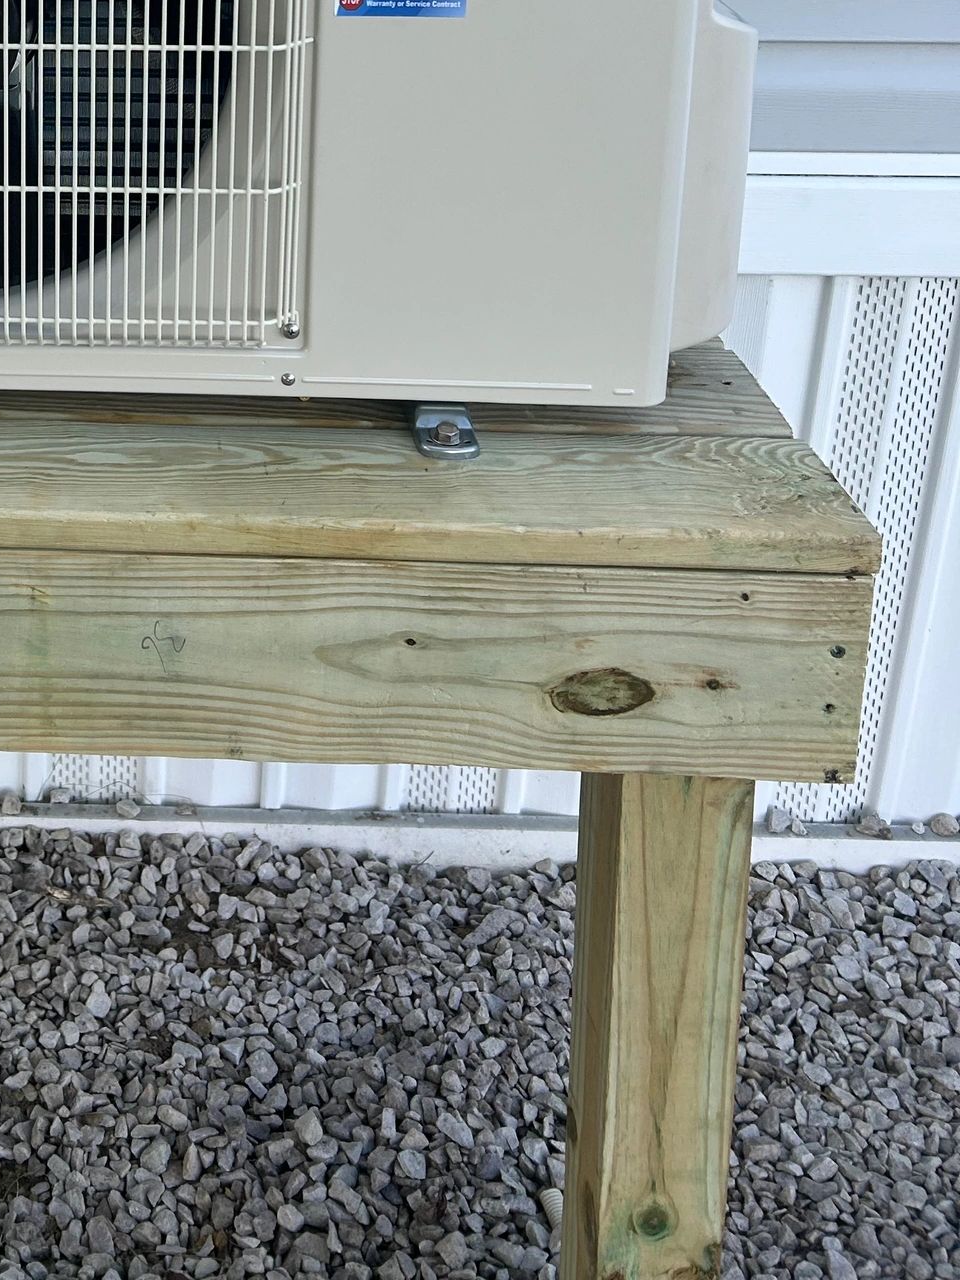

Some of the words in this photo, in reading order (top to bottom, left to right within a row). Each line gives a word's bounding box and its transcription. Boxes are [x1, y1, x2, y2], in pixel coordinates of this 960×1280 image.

[366, 0, 396, 9] Warranty
[405, 0, 431, 8] Service
[432, 0, 461, 8] Contract
